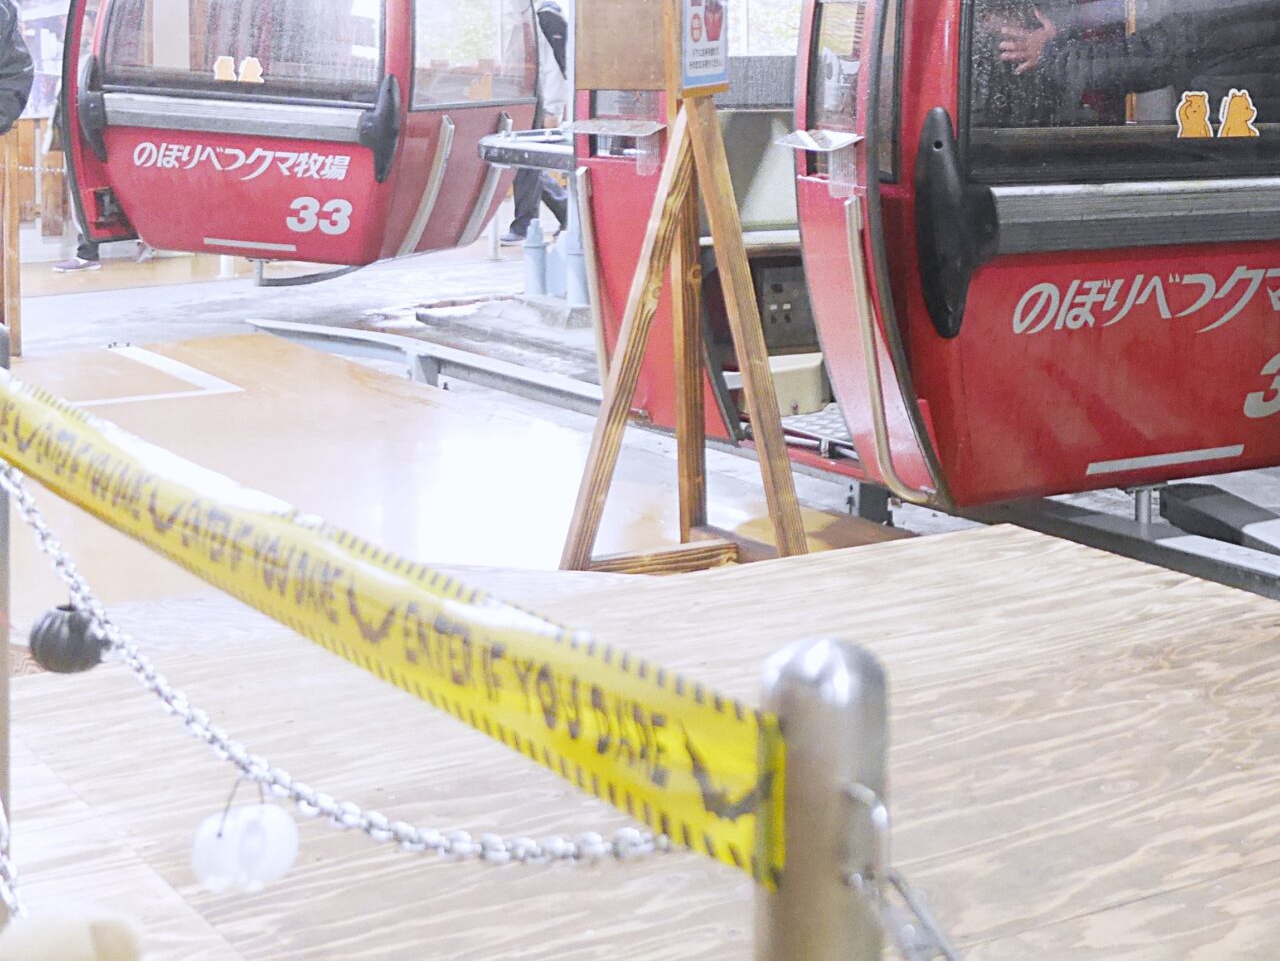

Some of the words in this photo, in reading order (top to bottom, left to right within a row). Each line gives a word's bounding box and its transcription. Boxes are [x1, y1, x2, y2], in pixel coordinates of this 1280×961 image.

[133, 142, 351, 181] のぼりべつクマ牧場
[286, 196, 353, 235] 33
[517, 657, 580, 739] YOU
[591, 684, 668, 787] DARE
